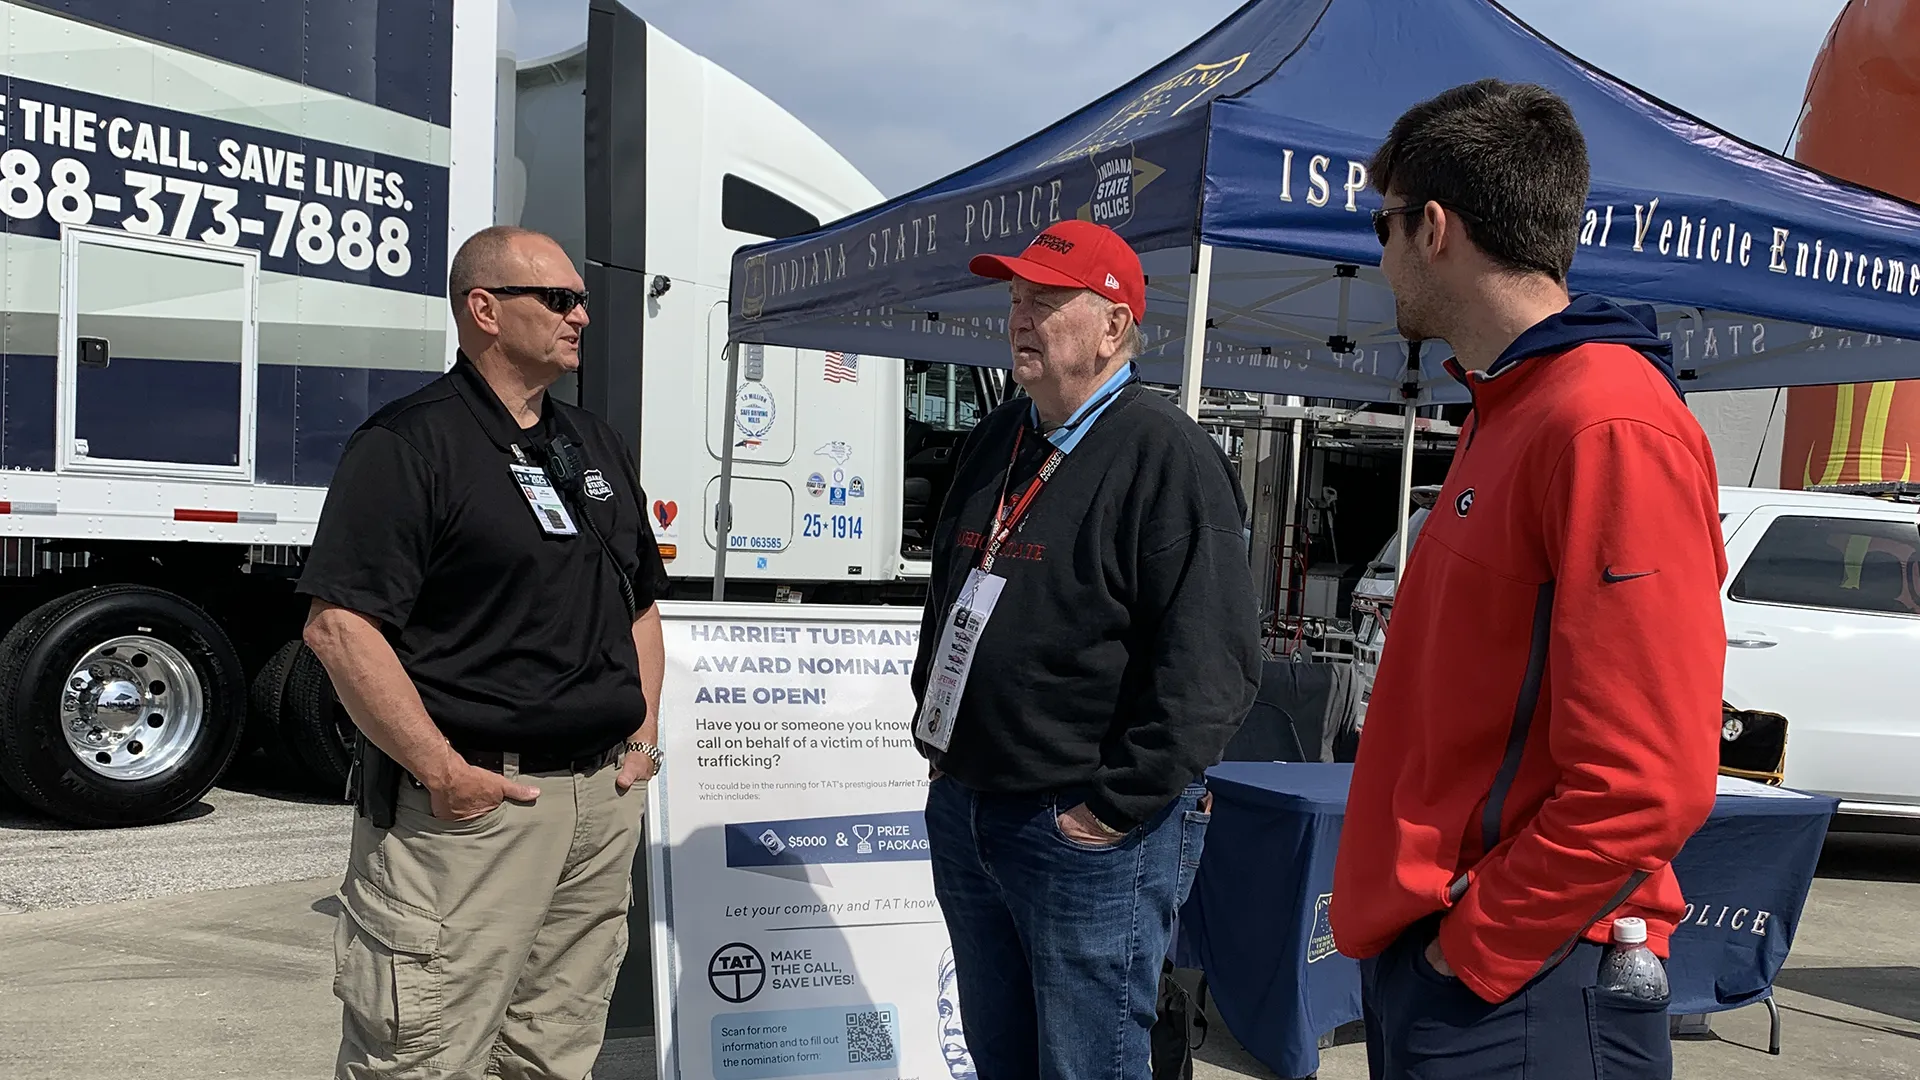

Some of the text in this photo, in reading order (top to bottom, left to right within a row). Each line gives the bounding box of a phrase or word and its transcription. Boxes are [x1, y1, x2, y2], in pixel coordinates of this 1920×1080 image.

[19, 98, 97, 153] THE
[108, 116, 209, 173] CALL.
[217, 139, 306, 191] SAVE
[315, 158, 414, 211] LIVES.
[1097, 159, 1132, 181] INDIANA
[1097, 176, 1130, 200] STATE
[1280, 149, 1368, 212] ISP
[0, 148, 412, 278] 88-373-7888
[1094, 196, 1130, 221] POLICE
[771, 179, 1063, 296] INDIANA STATE POLICE
[1032, 240, 1071, 255] ATION
[1633, 198, 1751, 267] Vehicle
[1769, 227, 1920, 296] Enforceme
[803, 513, 862, 539] 25 1914
[731, 536, 782, 548] DOT 063585
[691, 625, 801, 644] HARRIET
[693, 655, 913, 675] AWARD NOMINAT
[694, 687, 826, 705] ARE OPEN!
[696, 718, 911, 733] Have you or someone you know
[696, 736, 916, 749] call on behalf of a victim of hum
[697, 754, 781, 769] trafficking?
[698, 782, 715, 790] You
[716, 782, 739, 790] could
[761, 781, 774, 789] the
[776, 781, 806, 791] running
[808, 780, 819, 788] for
[821, 780, 844, 788] TAT's
[845, 780, 887, 790] prestigious
[698, 792, 761, 801] which includes:
[877, 826, 910, 836] PRIZE
[788, 832, 849, 848] $5000 &
[725, 898, 936, 919] Let your company and TAT know
[1680, 903, 1771, 936] OLICE
[719, 955, 754, 969] TAT
[771, 949, 812, 961] MAKE
[771, 962, 842, 975] THE CALL,
[772, 975, 854, 989] SAVE LIVES!
[721, 1025, 787, 1037] Scan for more
[722, 1036, 839, 1052] information and to fill out
[723, 1052, 821, 1067] the nomination form:
